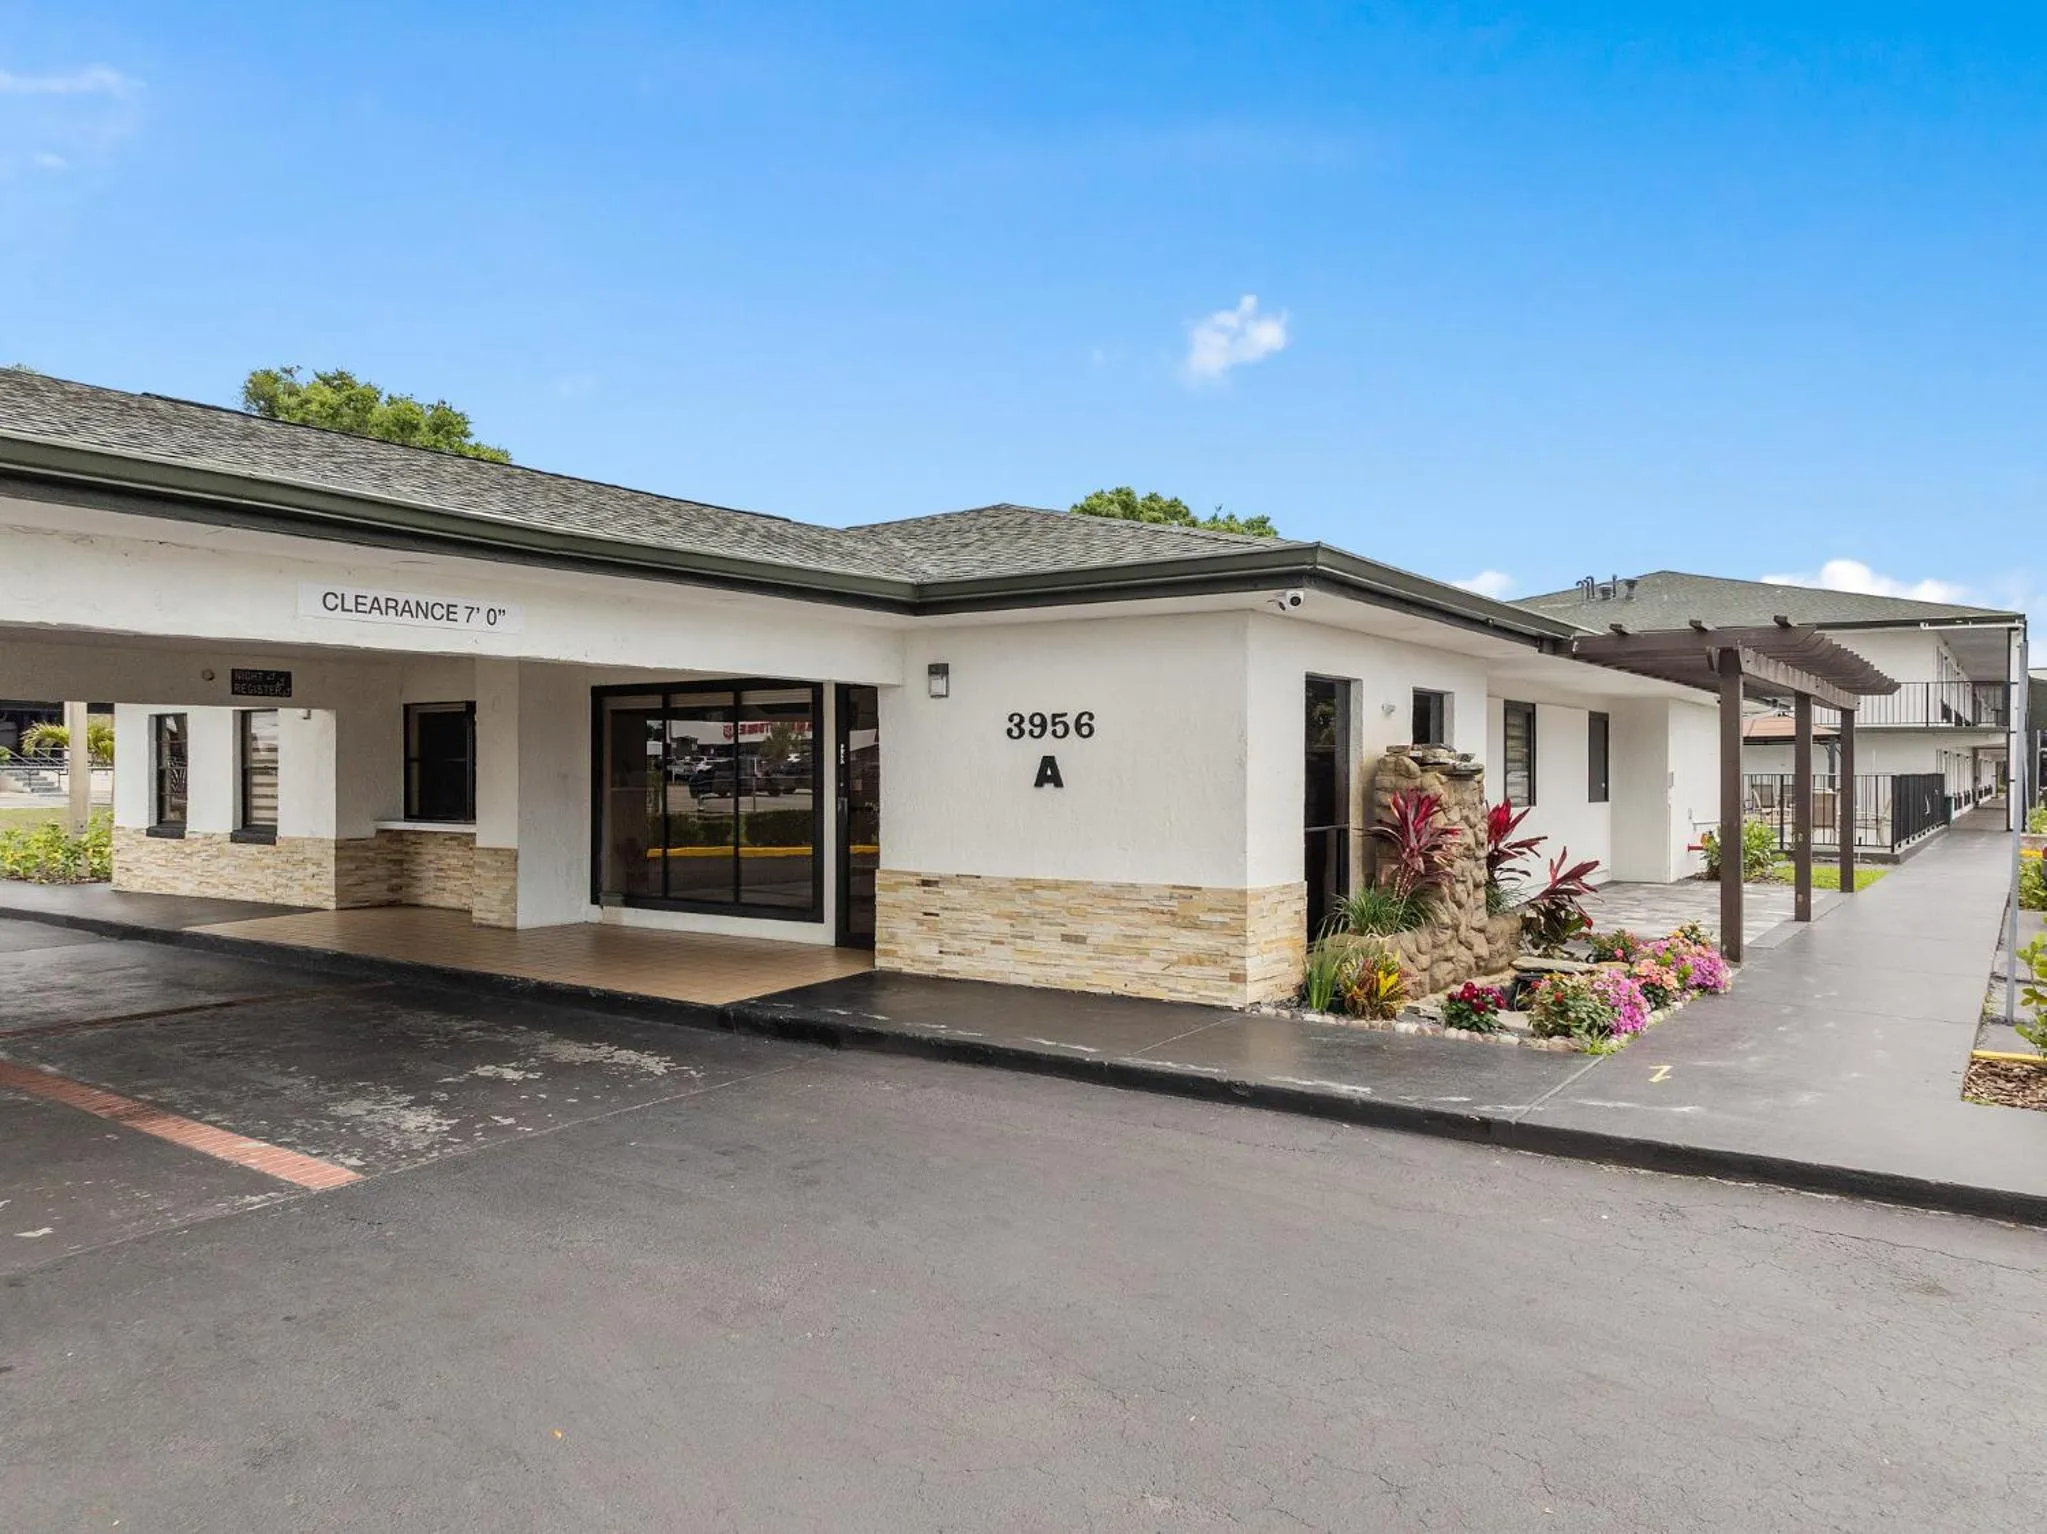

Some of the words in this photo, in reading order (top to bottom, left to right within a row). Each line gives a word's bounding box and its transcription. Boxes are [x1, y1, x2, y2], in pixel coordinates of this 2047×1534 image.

[322, 591, 458, 622] CLEARANCE
[1006, 711, 1095, 740] 3956
[1034, 755, 1064, 788] A
